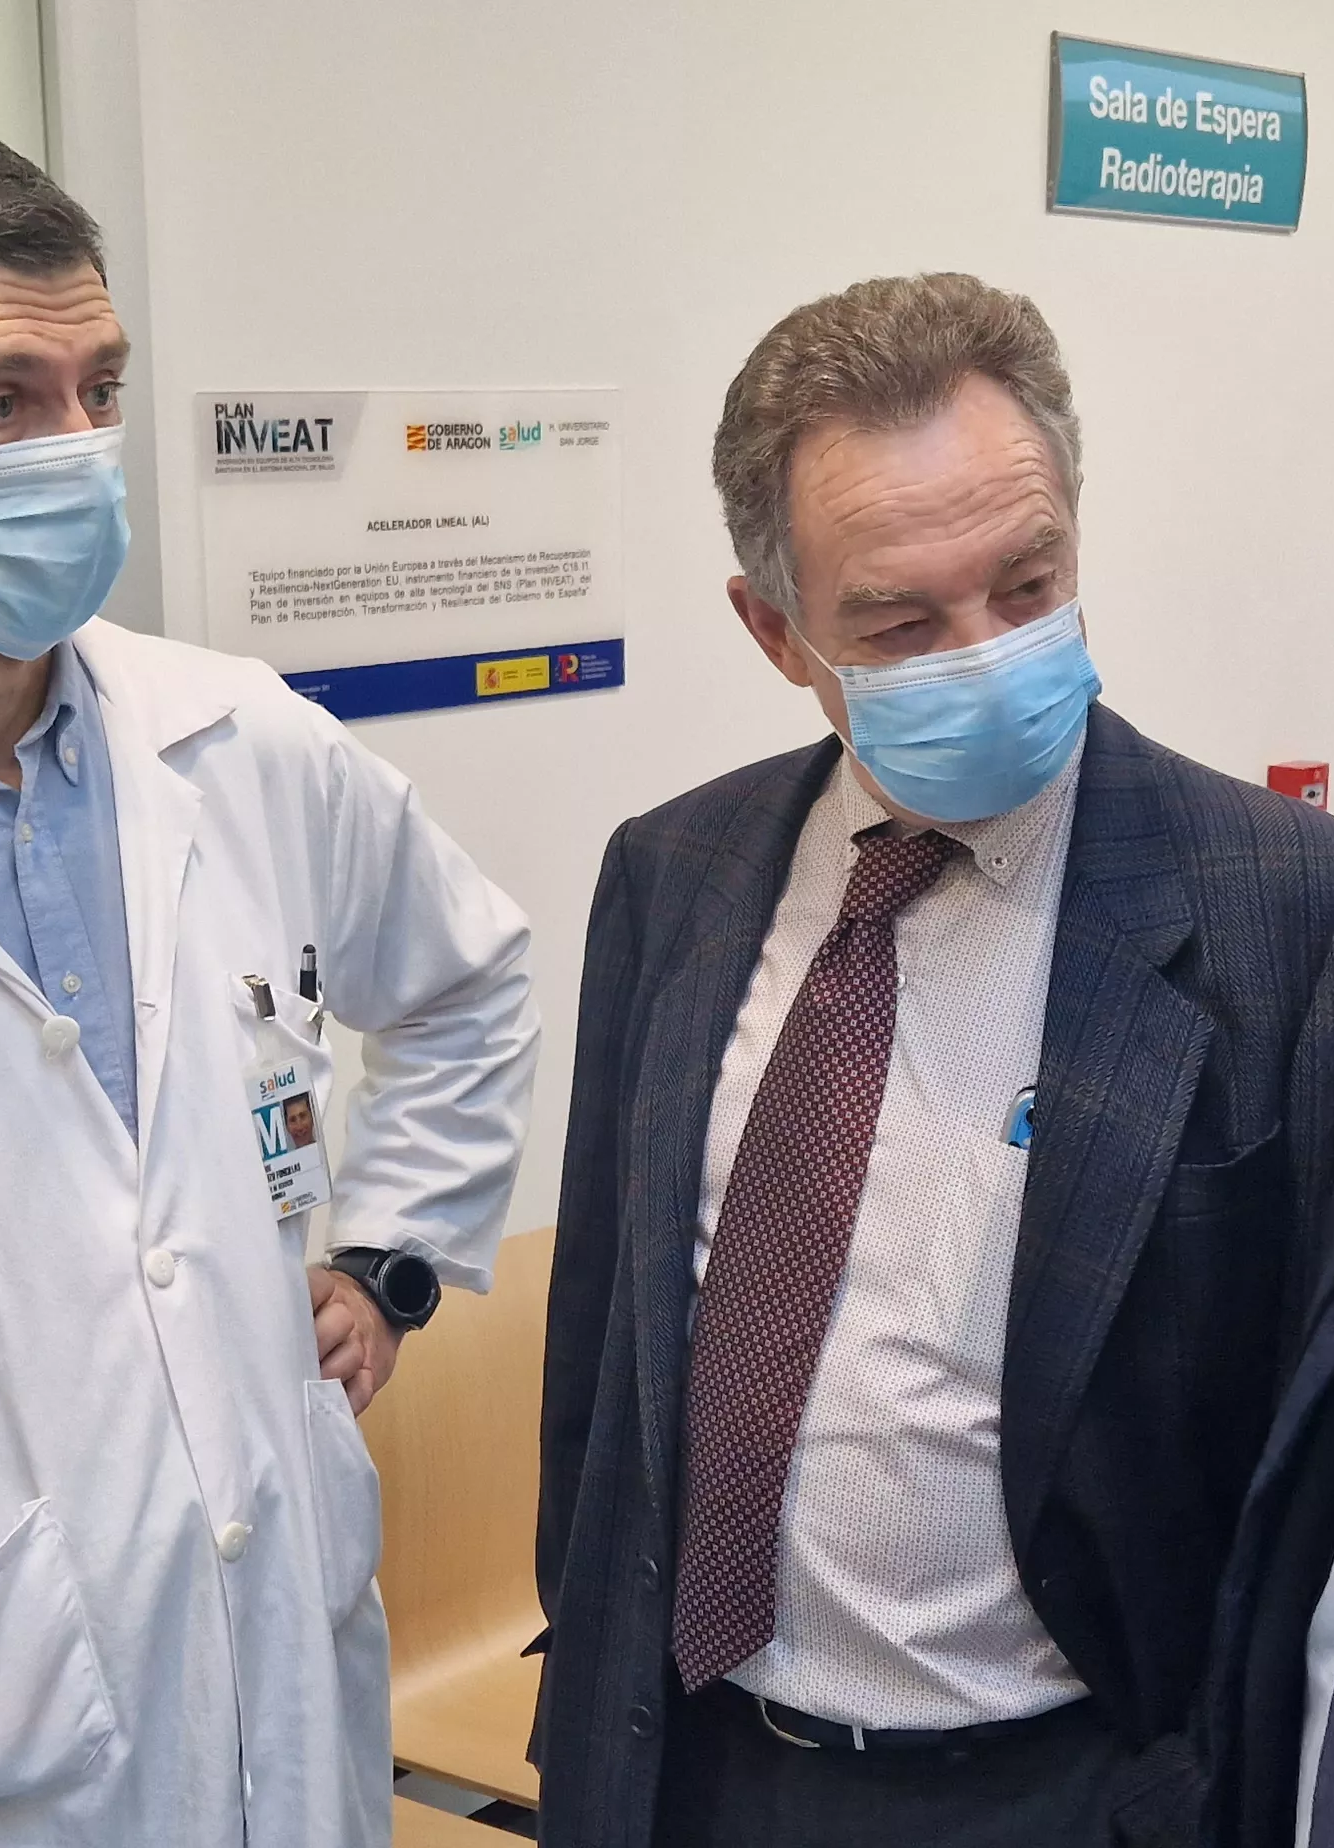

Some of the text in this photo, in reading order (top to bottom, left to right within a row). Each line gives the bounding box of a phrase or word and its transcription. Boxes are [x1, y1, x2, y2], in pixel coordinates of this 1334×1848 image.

[1089, 75, 1281, 144] Sala de Espera
[1100, 147, 1263, 210] Radioterapia
[214, 403, 254, 419] PLAN
[216, 418, 334, 454] INVEAT
[427, 423, 483, 436] GOBIERNO
[499, 421, 542, 442] salud
[427, 438, 441, 450] DE
[367, 515, 490, 532] ACELERADOR LINEAL (AL)
[288, 567, 334, 579] financiado
[337, 567, 351, 577] por
[354, 564, 362, 574] la
[365, 562, 389, 574] Unión
[392, 561, 428, 573] Europea
[430, 561, 435, 569] a
[438, 558, 463, 569] través
[466, 557, 478, 567] del
[480, 554, 525, 566] Mecanismo
[527, 553, 537, 562] de
[249, 588, 255, 598] y
[405, 572, 454, 585] instrumento
[458, 570, 497, 580] financiero
[501, 567, 510, 577] de
[250, 599, 271, 610] Plan
[277, 598, 288, 608] de
[293, 595, 334, 606] inversión
[339, 594, 350, 603] en
[356, 592, 389, 604] equipos
[394, 589, 405, 599] de
[410, 587, 425, 597] alta
[430, 584, 472, 597] tecnología
[477, 582, 489, 592] del
[251, 614, 272, 624] Plan
[277, 612, 288, 622] de
[432, 602, 437, 612] y
[489, 594, 501, 604] del
[545, 590, 554, 599] de
[260, 1066, 296, 1094] salud
[254, 1104, 288, 1156] M
